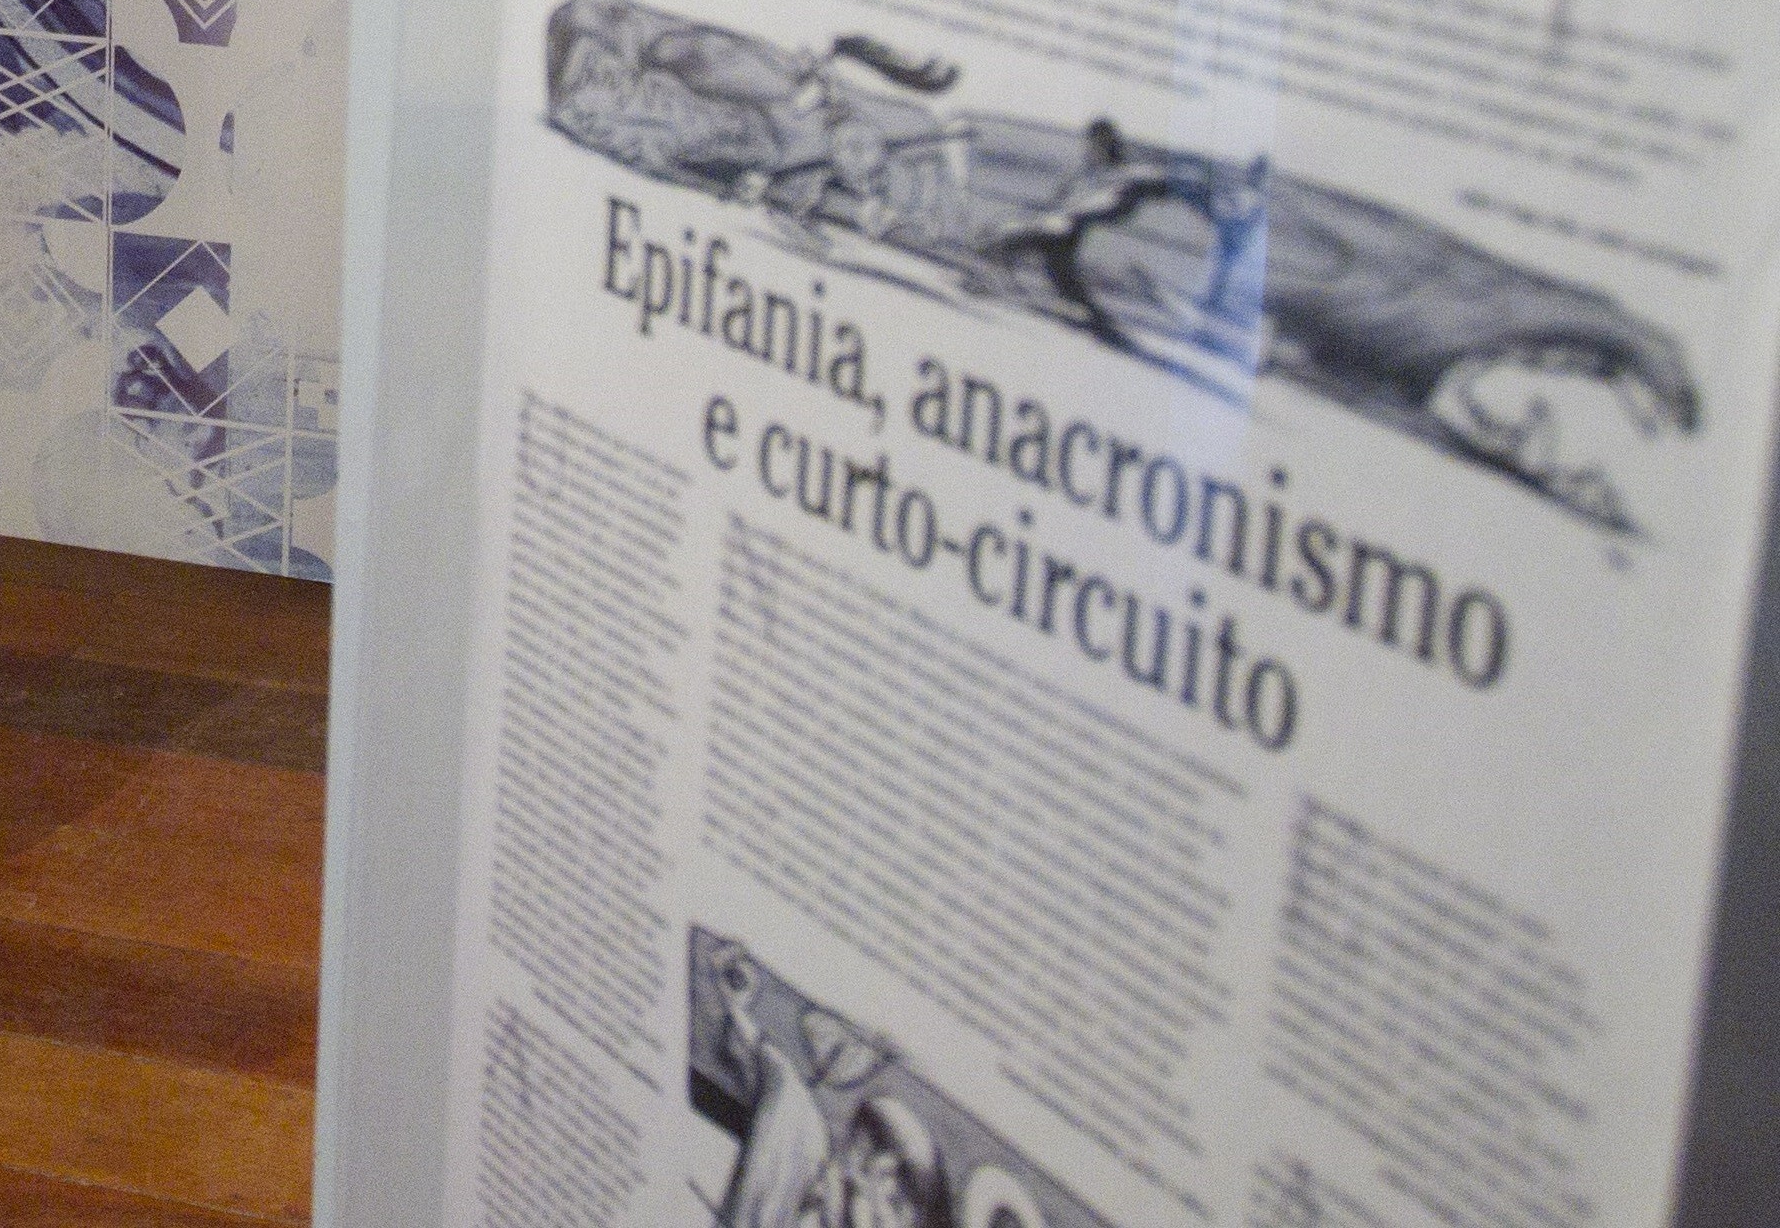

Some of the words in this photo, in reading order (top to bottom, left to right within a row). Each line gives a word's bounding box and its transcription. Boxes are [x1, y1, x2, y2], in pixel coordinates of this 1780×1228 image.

[604, 194, 886, 434] Epifania,
[910, 355, 1509, 691] anacronismo
[702, 394, 739, 472] e
[758, 422, 1301, 752] curto-circuito
